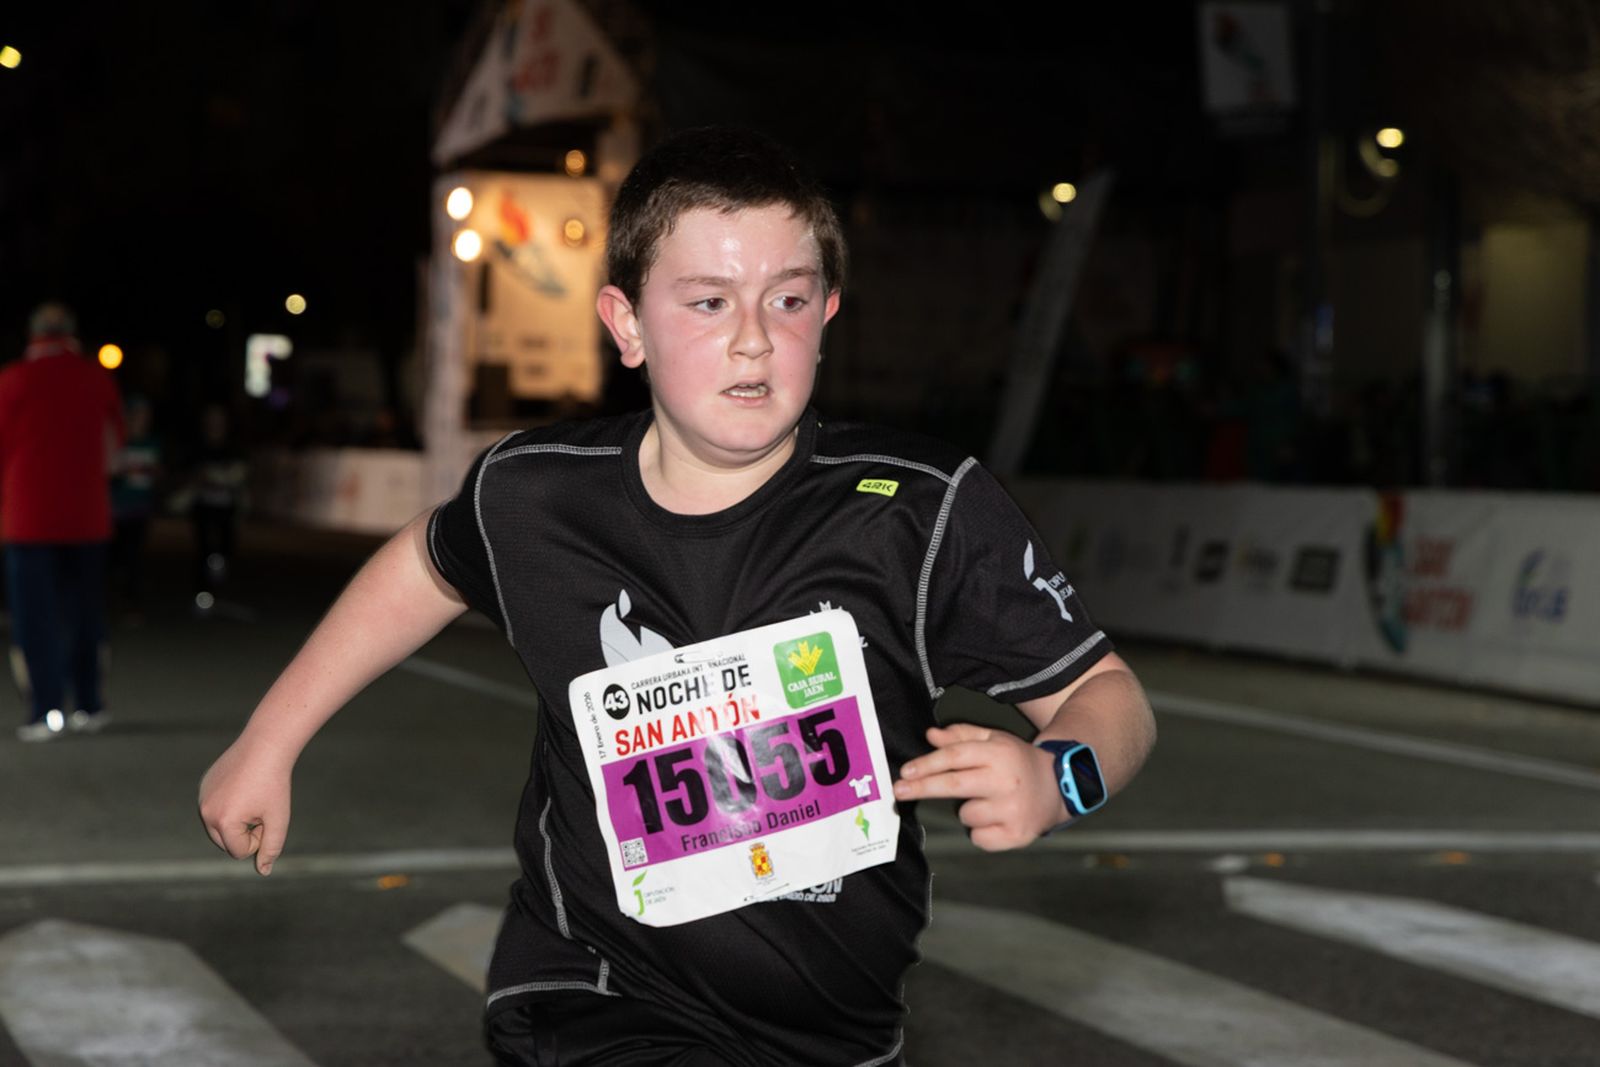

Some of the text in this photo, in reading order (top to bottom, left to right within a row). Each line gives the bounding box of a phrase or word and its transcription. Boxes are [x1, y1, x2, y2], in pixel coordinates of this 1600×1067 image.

[631, 654, 746, 690] CARRERA URBANA INTRNACIONAL
[721, 664, 752, 692] DE
[604, 689, 630, 712] 43
[614, 692, 761, 756] SAN ANTÓN
[622, 708, 850, 835] 15055
[766, 800, 821, 829] Daniel
